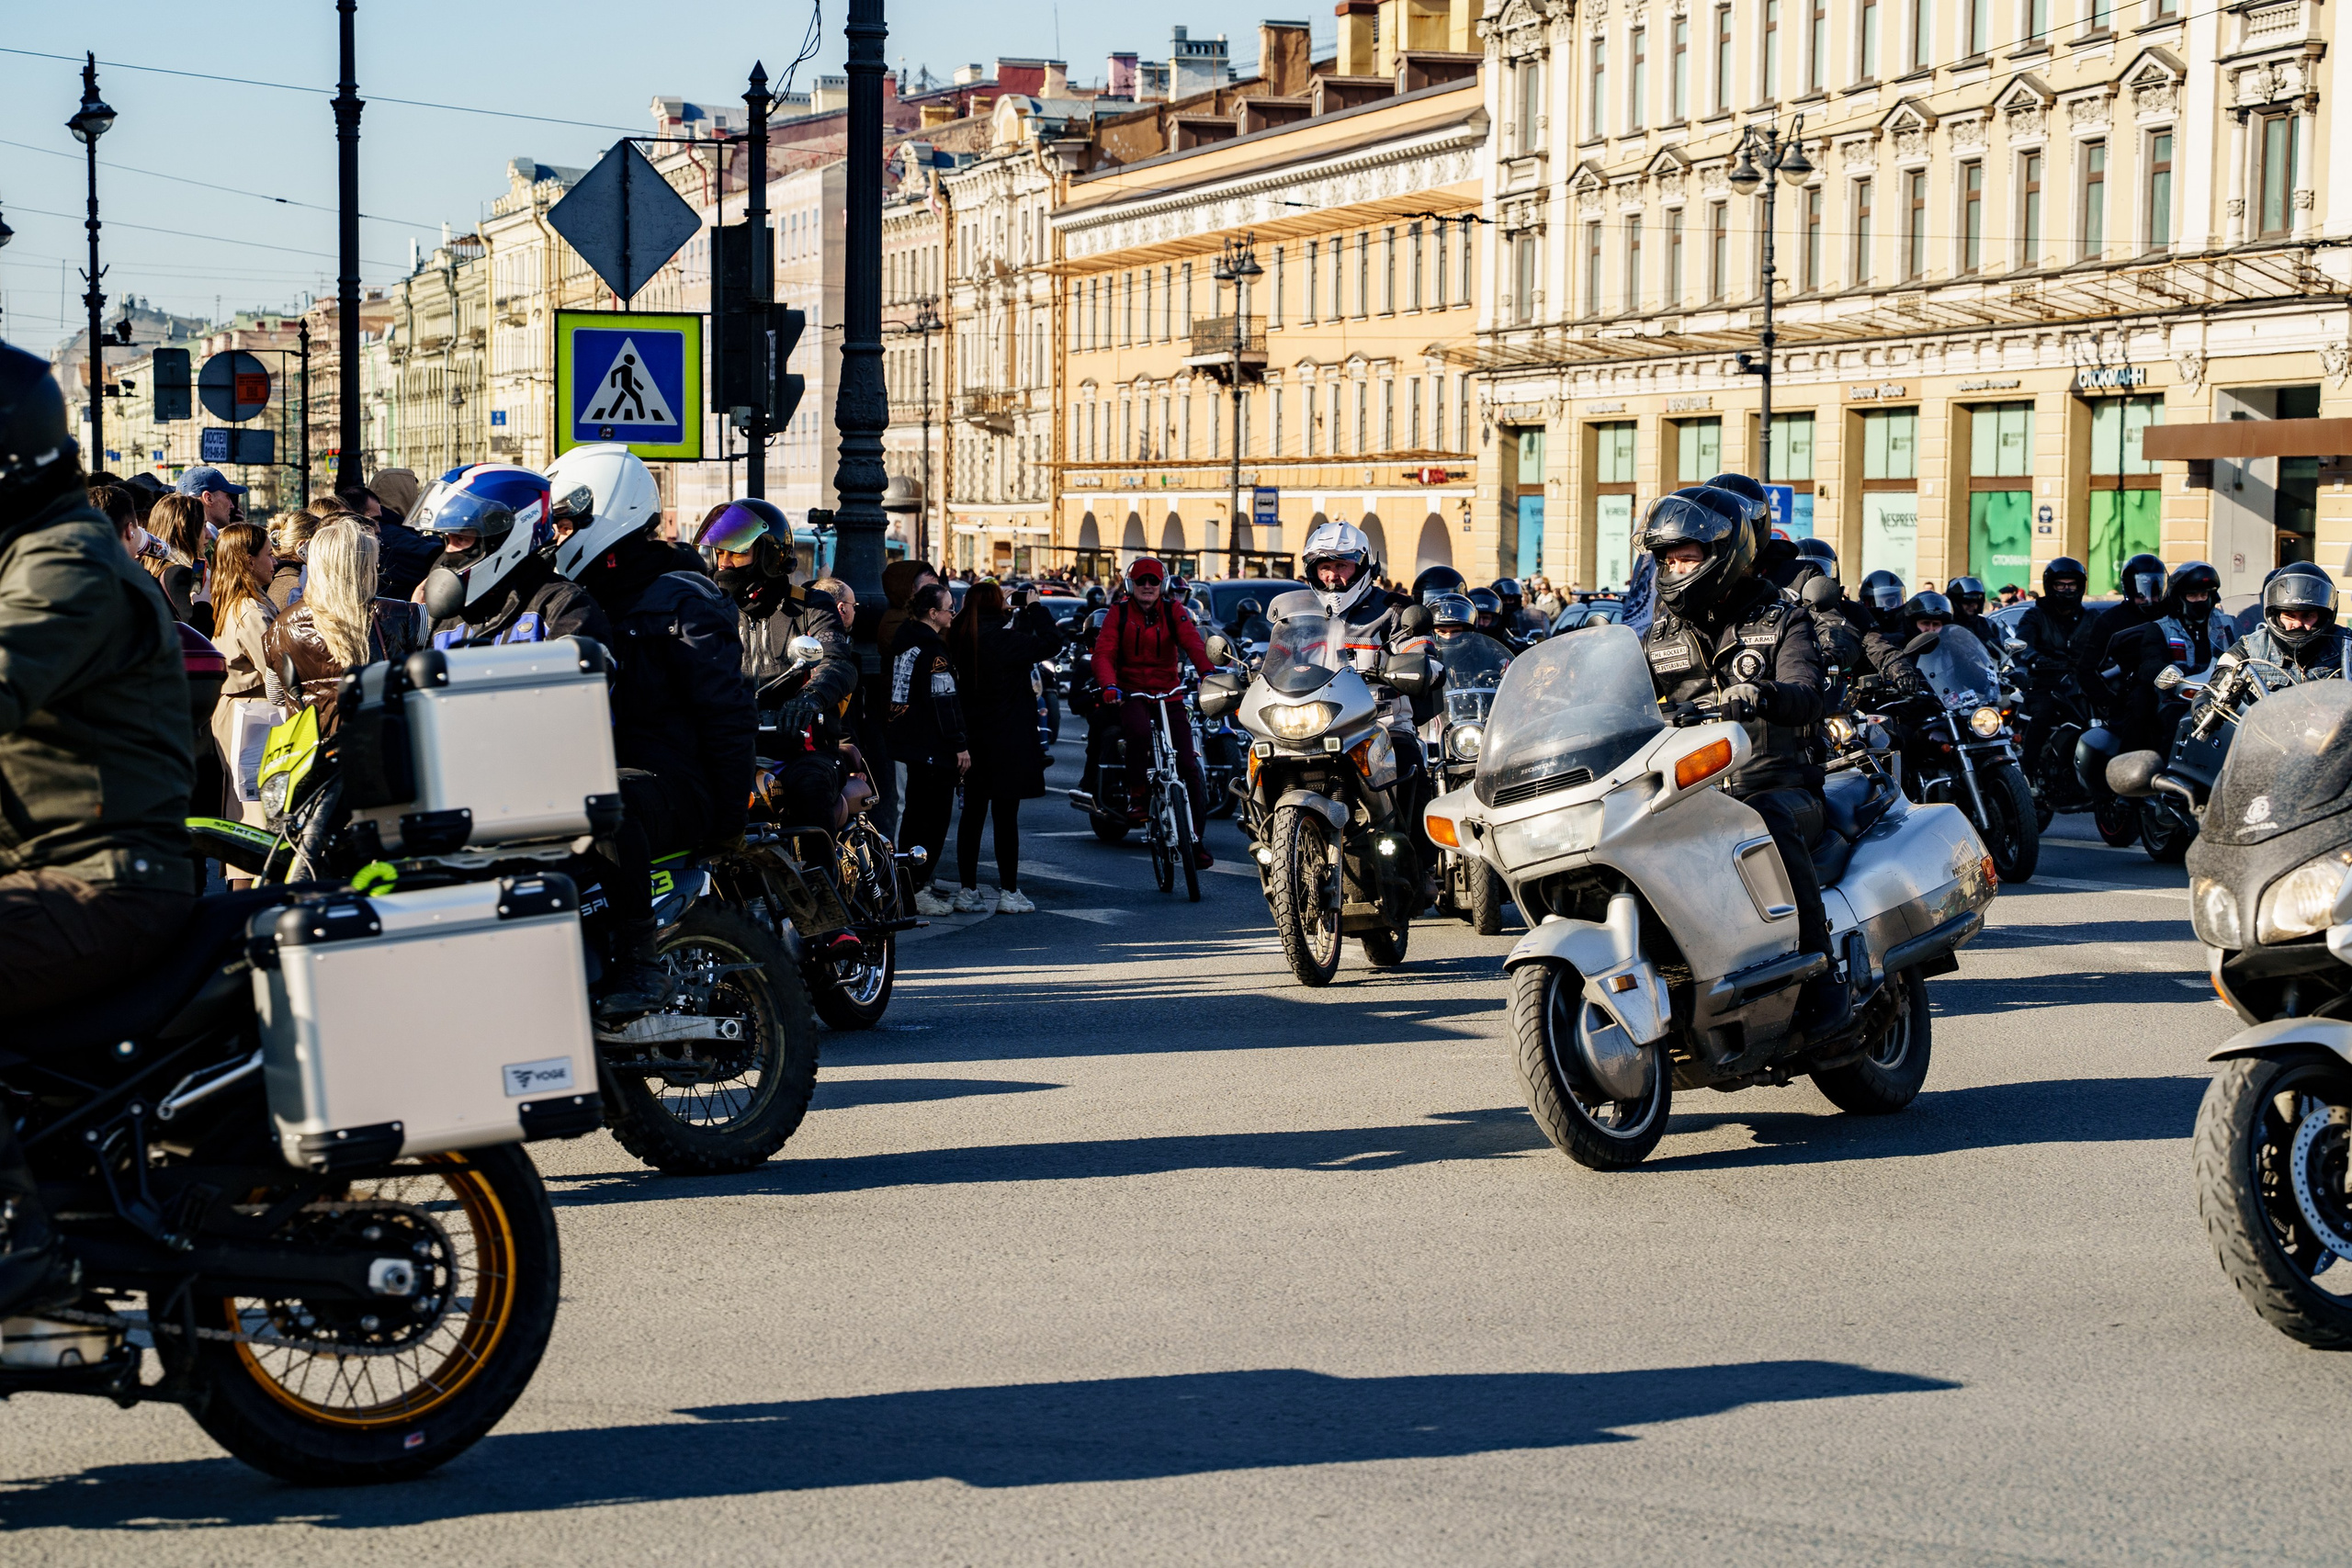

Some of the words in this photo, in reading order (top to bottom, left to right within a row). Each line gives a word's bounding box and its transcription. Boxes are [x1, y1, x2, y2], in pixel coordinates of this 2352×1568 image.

[205, 431, 227, 444] ХОСТЕЛ
[1663, 647, 1686, 659] ROCKERS
[1520, 761, 1558, 776] HONDA
[2234, 821, 2278, 837] HONDA
